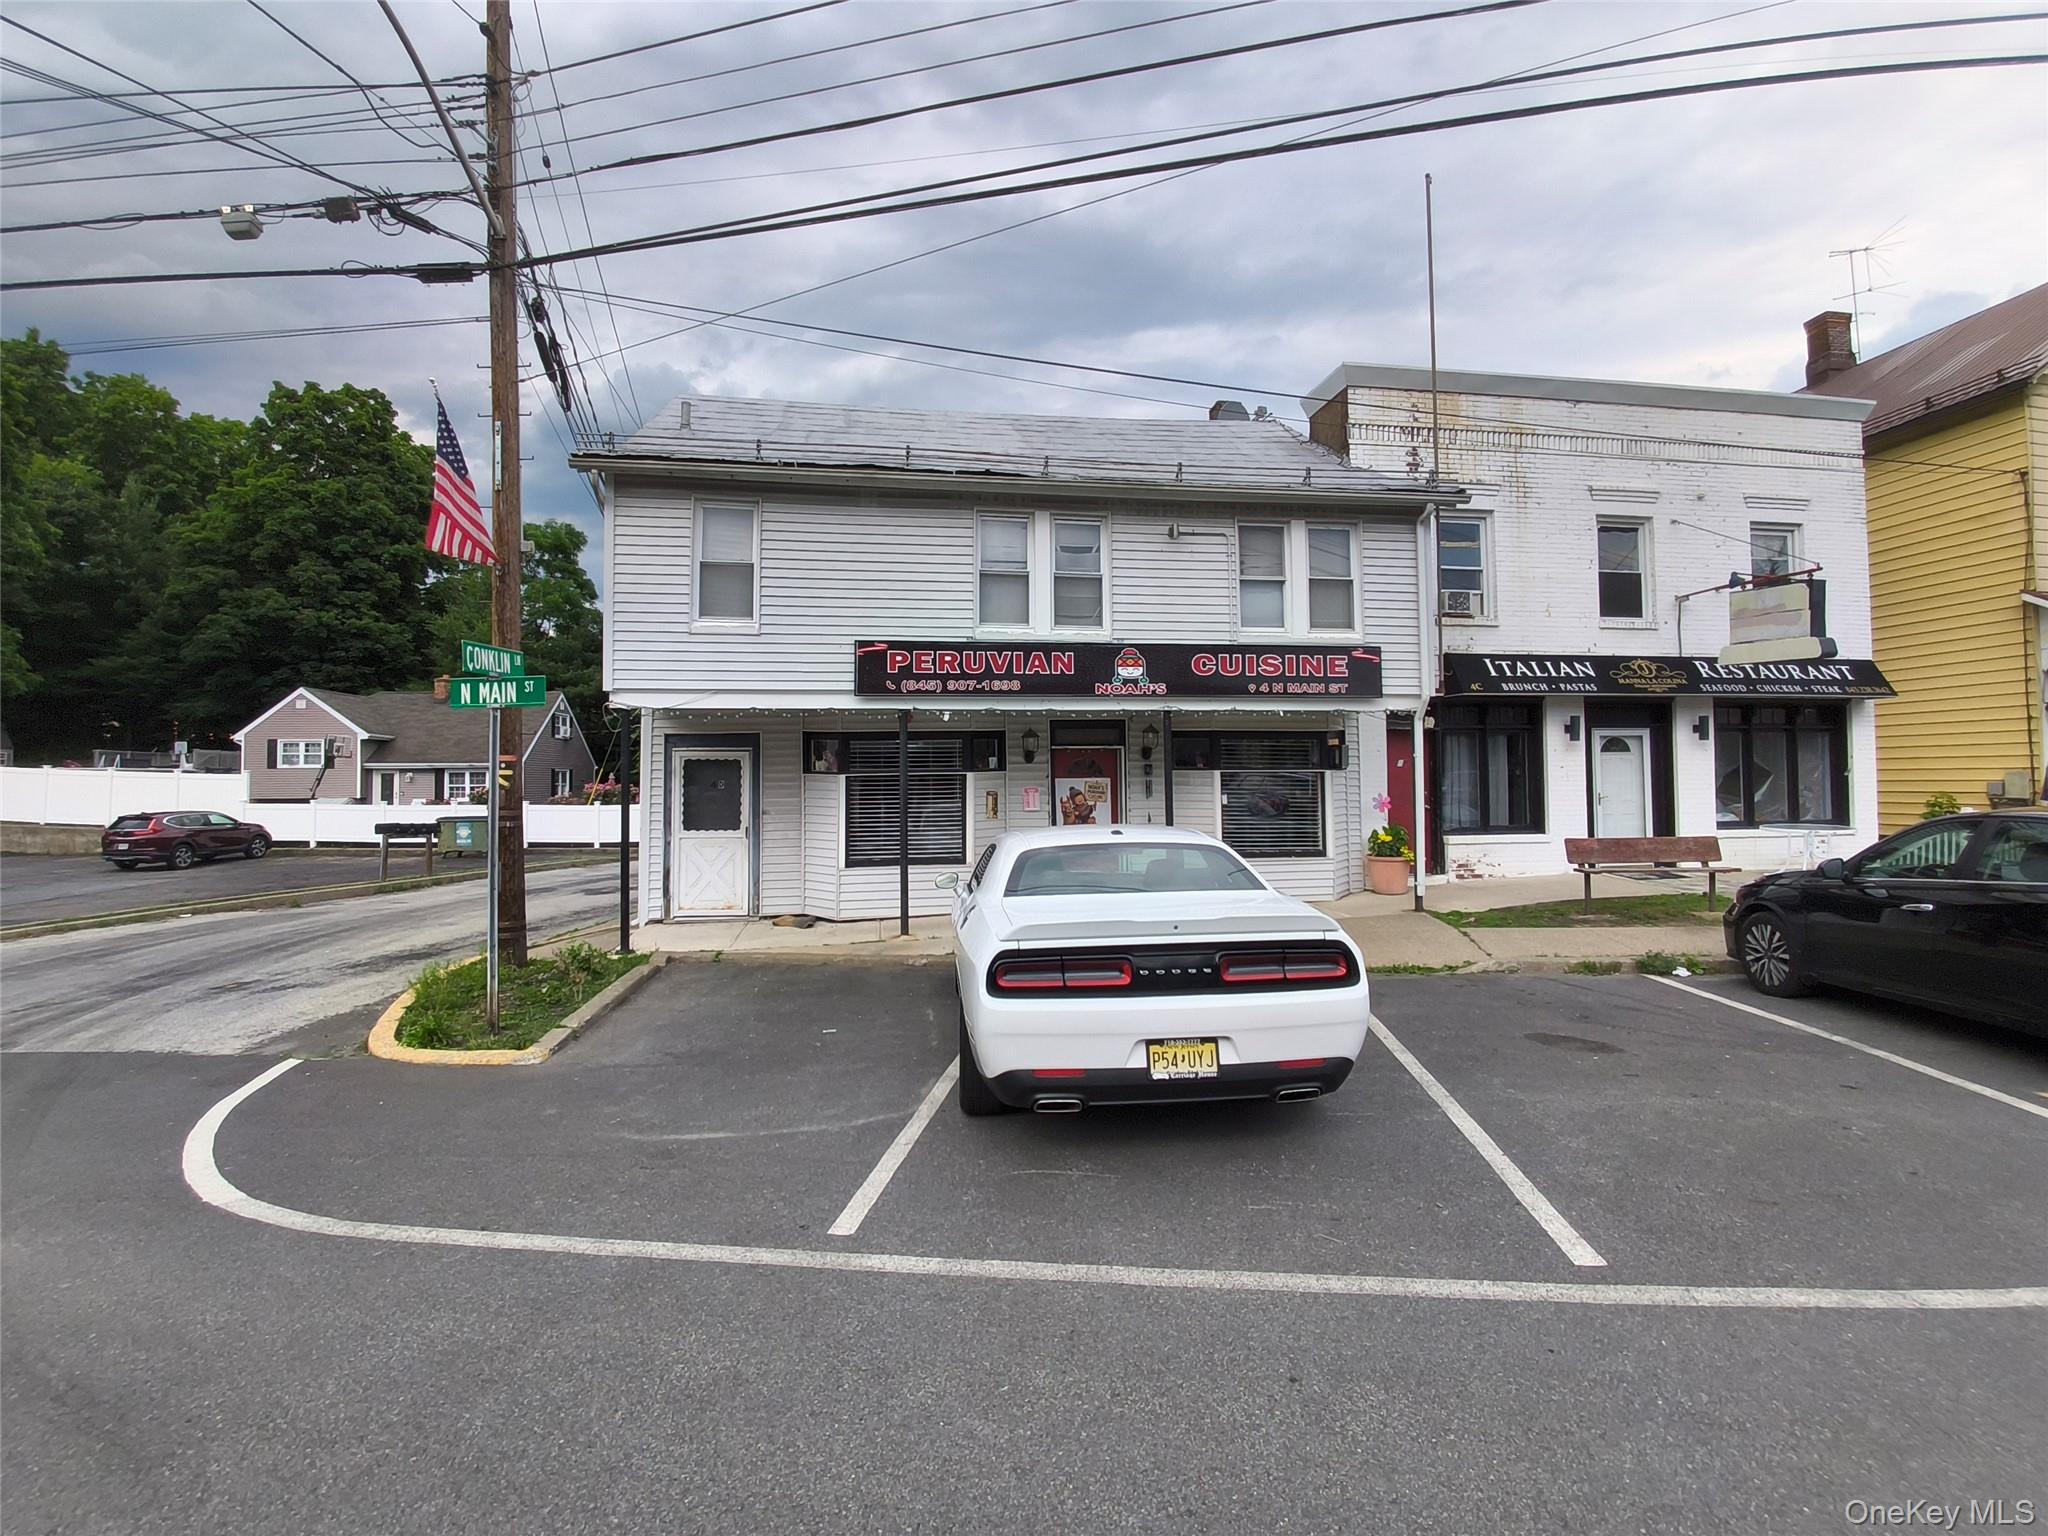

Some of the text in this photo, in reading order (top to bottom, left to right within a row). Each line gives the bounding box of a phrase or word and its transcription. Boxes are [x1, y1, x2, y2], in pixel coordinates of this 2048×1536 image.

[466, 646, 521, 674] CONKLIN LN
[887, 650, 1075, 674] PERUVIAN
[1191, 653, 1349, 677] CUISINE
[1482, 658, 1596, 677] ITALIAN
[1692, 660, 1855, 680] RESTAURANT
[461, 681, 534, 704] N MAIN ST
[900, 680, 943, 693] (845)
[1095, 683, 1167, 695] NOAH'S
[1259, 683, 1348, 694] 4 N MAIN ST
[1470, 683, 1484, 691] 4C
[1501, 683, 1597, 691] BRUNCH PASTAS
[1700, 684, 1747, 692] SEAFOOD
[1756, 684, 1804, 693] CHICKEN
[1811, 685, 1843, 693] STEAK
[1188, 1049, 1214, 1069] UYJ
